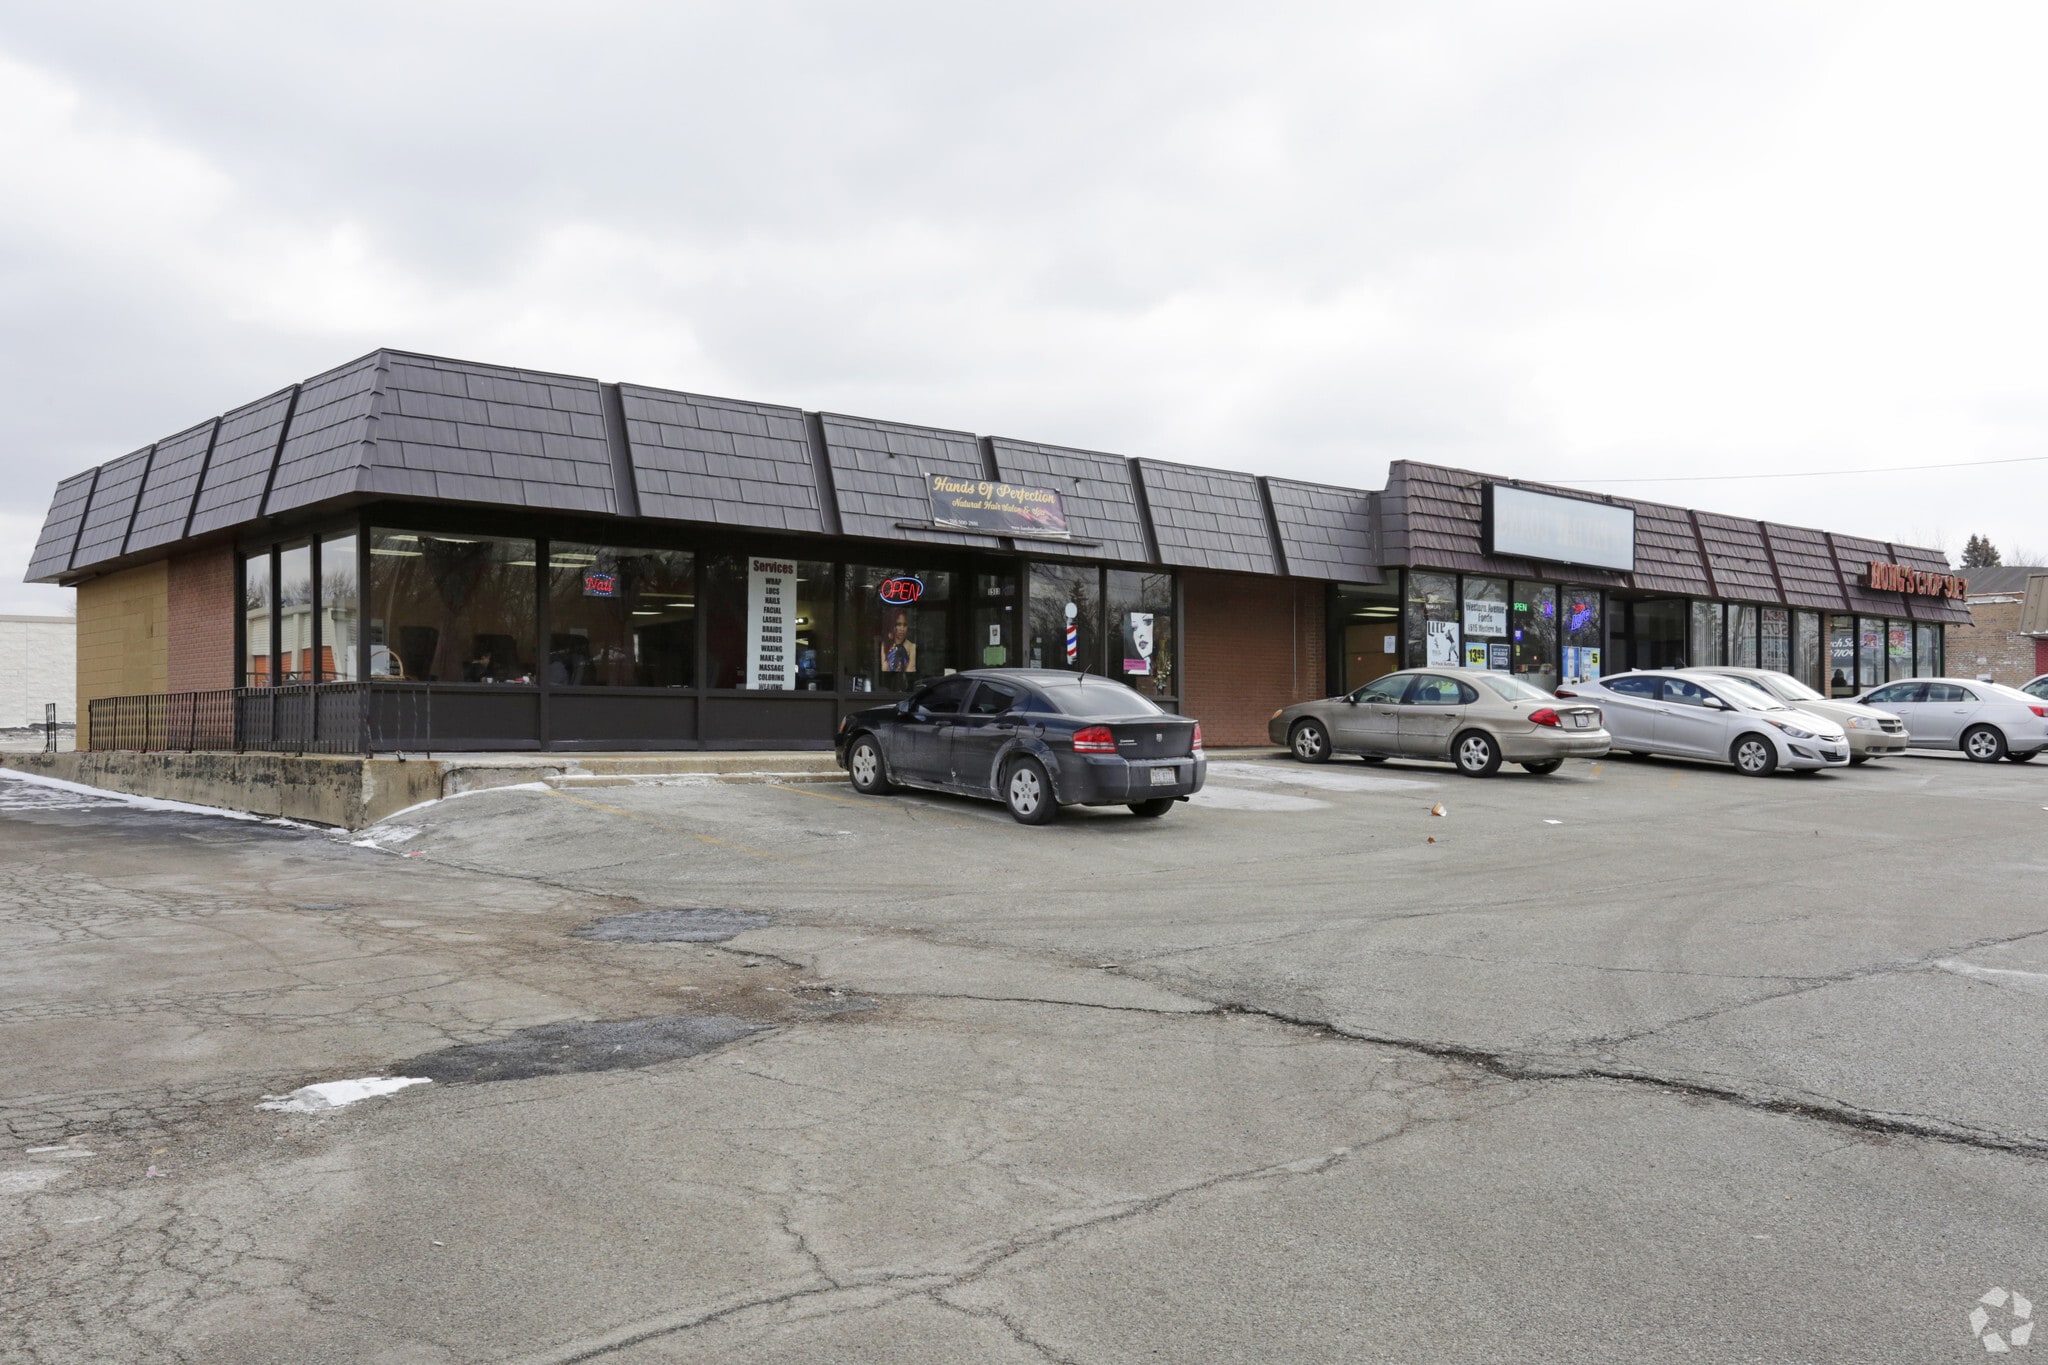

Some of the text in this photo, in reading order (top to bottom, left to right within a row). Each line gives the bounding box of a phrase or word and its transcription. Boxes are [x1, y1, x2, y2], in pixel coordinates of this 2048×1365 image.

[933, 476, 1056, 504] Hands Of Perfection
[952, 497, 982, 510] Natural
[983, 501, 1000, 511] Hair
[753, 560, 793, 574] Services
[1916, 571, 1943, 597] CHOP
[881, 579, 920, 602] OPEN
[765, 597, 780, 605] NAILS
[763, 606, 781, 614] FACIAL
[762, 615, 782, 624] LASHES
[762, 625, 782, 633] BRAIDS
[761, 635, 783, 643] BARBER
[760, 654, 784, 662] MAKE-UP
[759, 664, 784, 672] MASSAGE
